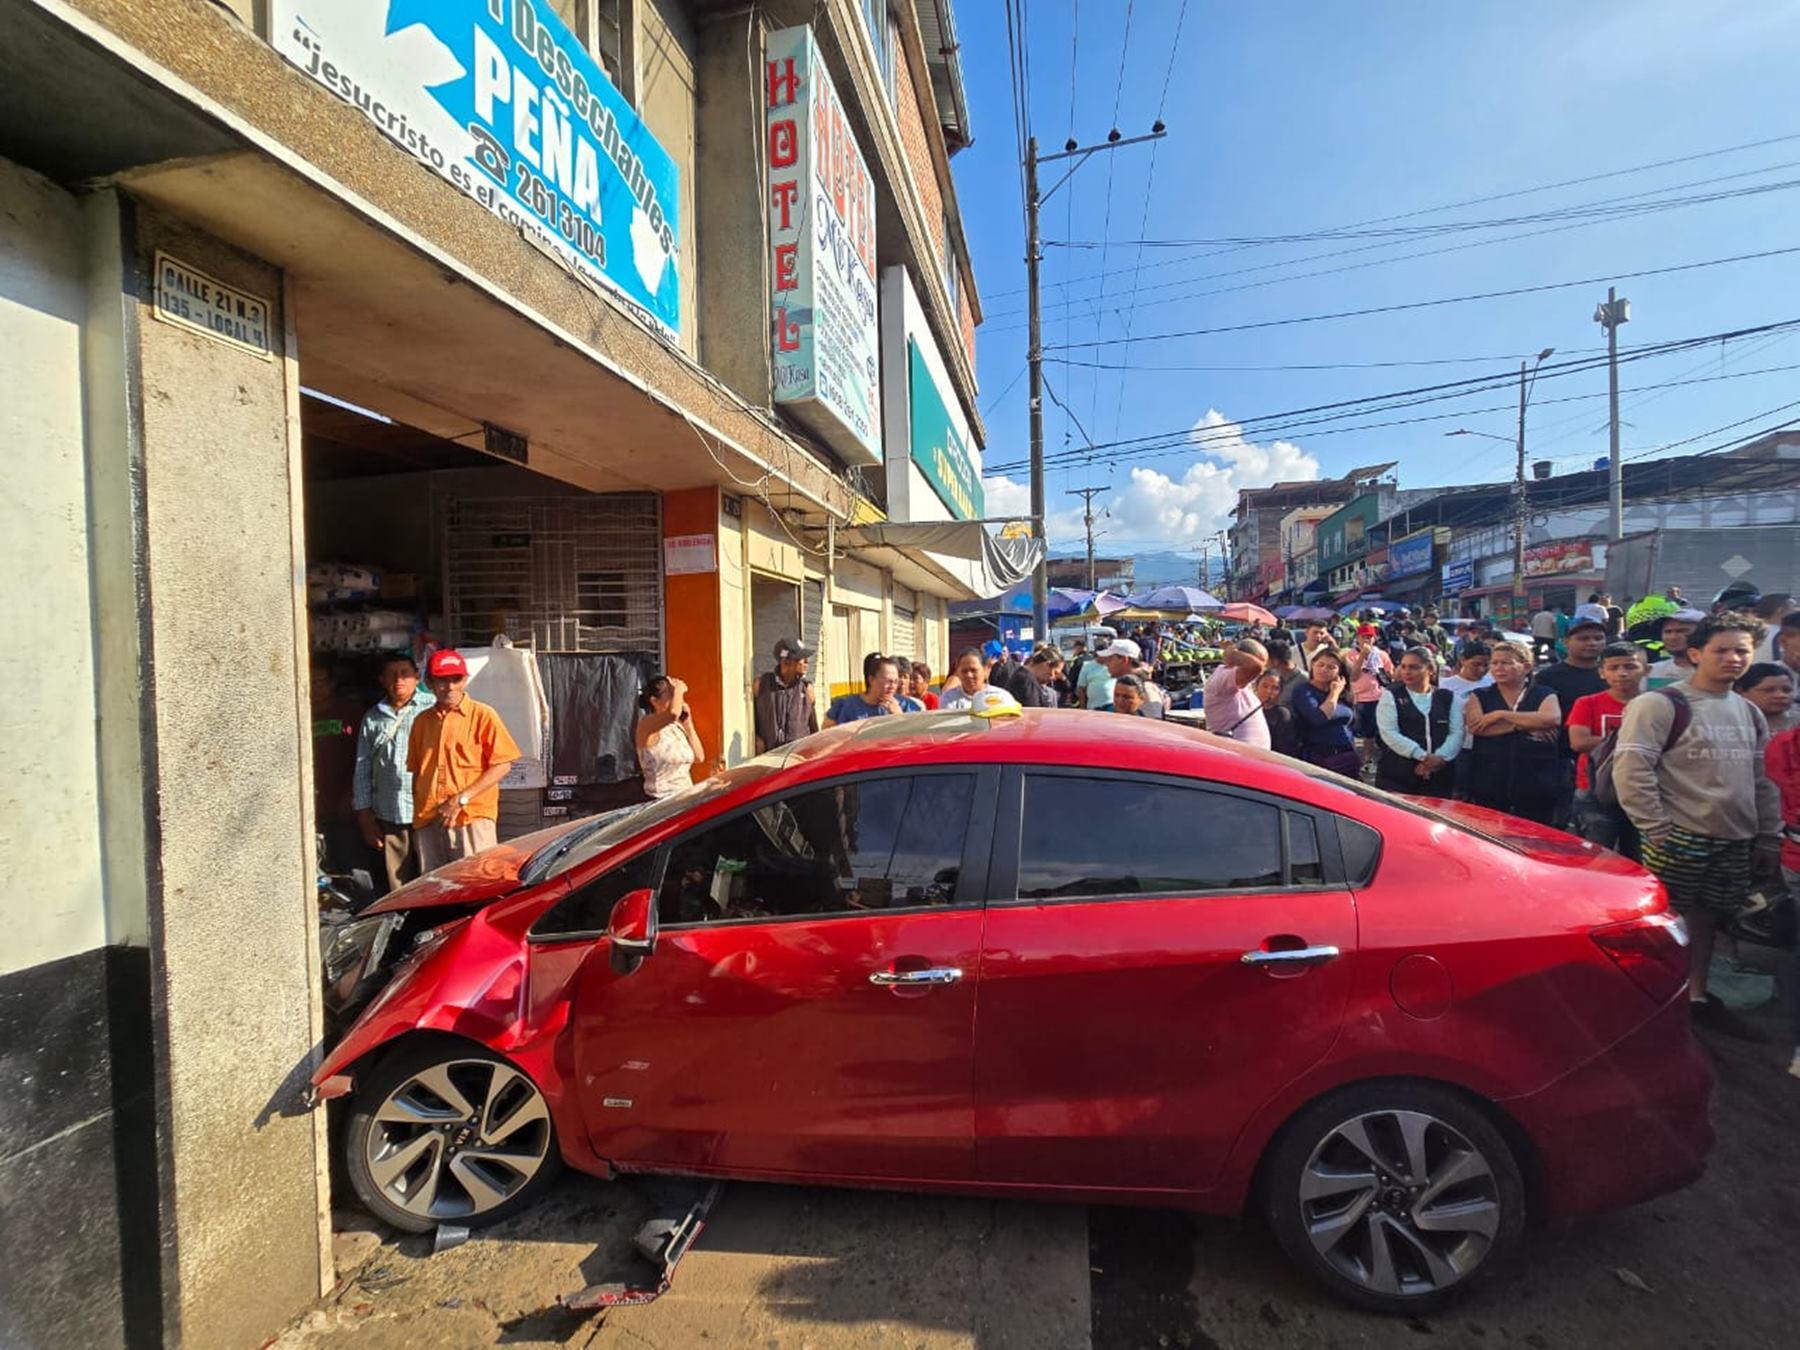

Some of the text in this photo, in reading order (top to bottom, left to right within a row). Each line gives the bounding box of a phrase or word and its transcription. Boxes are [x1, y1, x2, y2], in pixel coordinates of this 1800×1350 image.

[450, 166, 472, 192] es
[477, 178, 495, 209] el
[474, 22, 603, 226] PEÑA
[815, 60, 876, 285] HOTEL
[767, 56, 801, 354] HOTEL
[163, 291, 190, 320] 135
[208, 309, 248, 344] LOCAL
[165, 266, 210, 305] CALLE
[215, 290, 232, 314] 21
